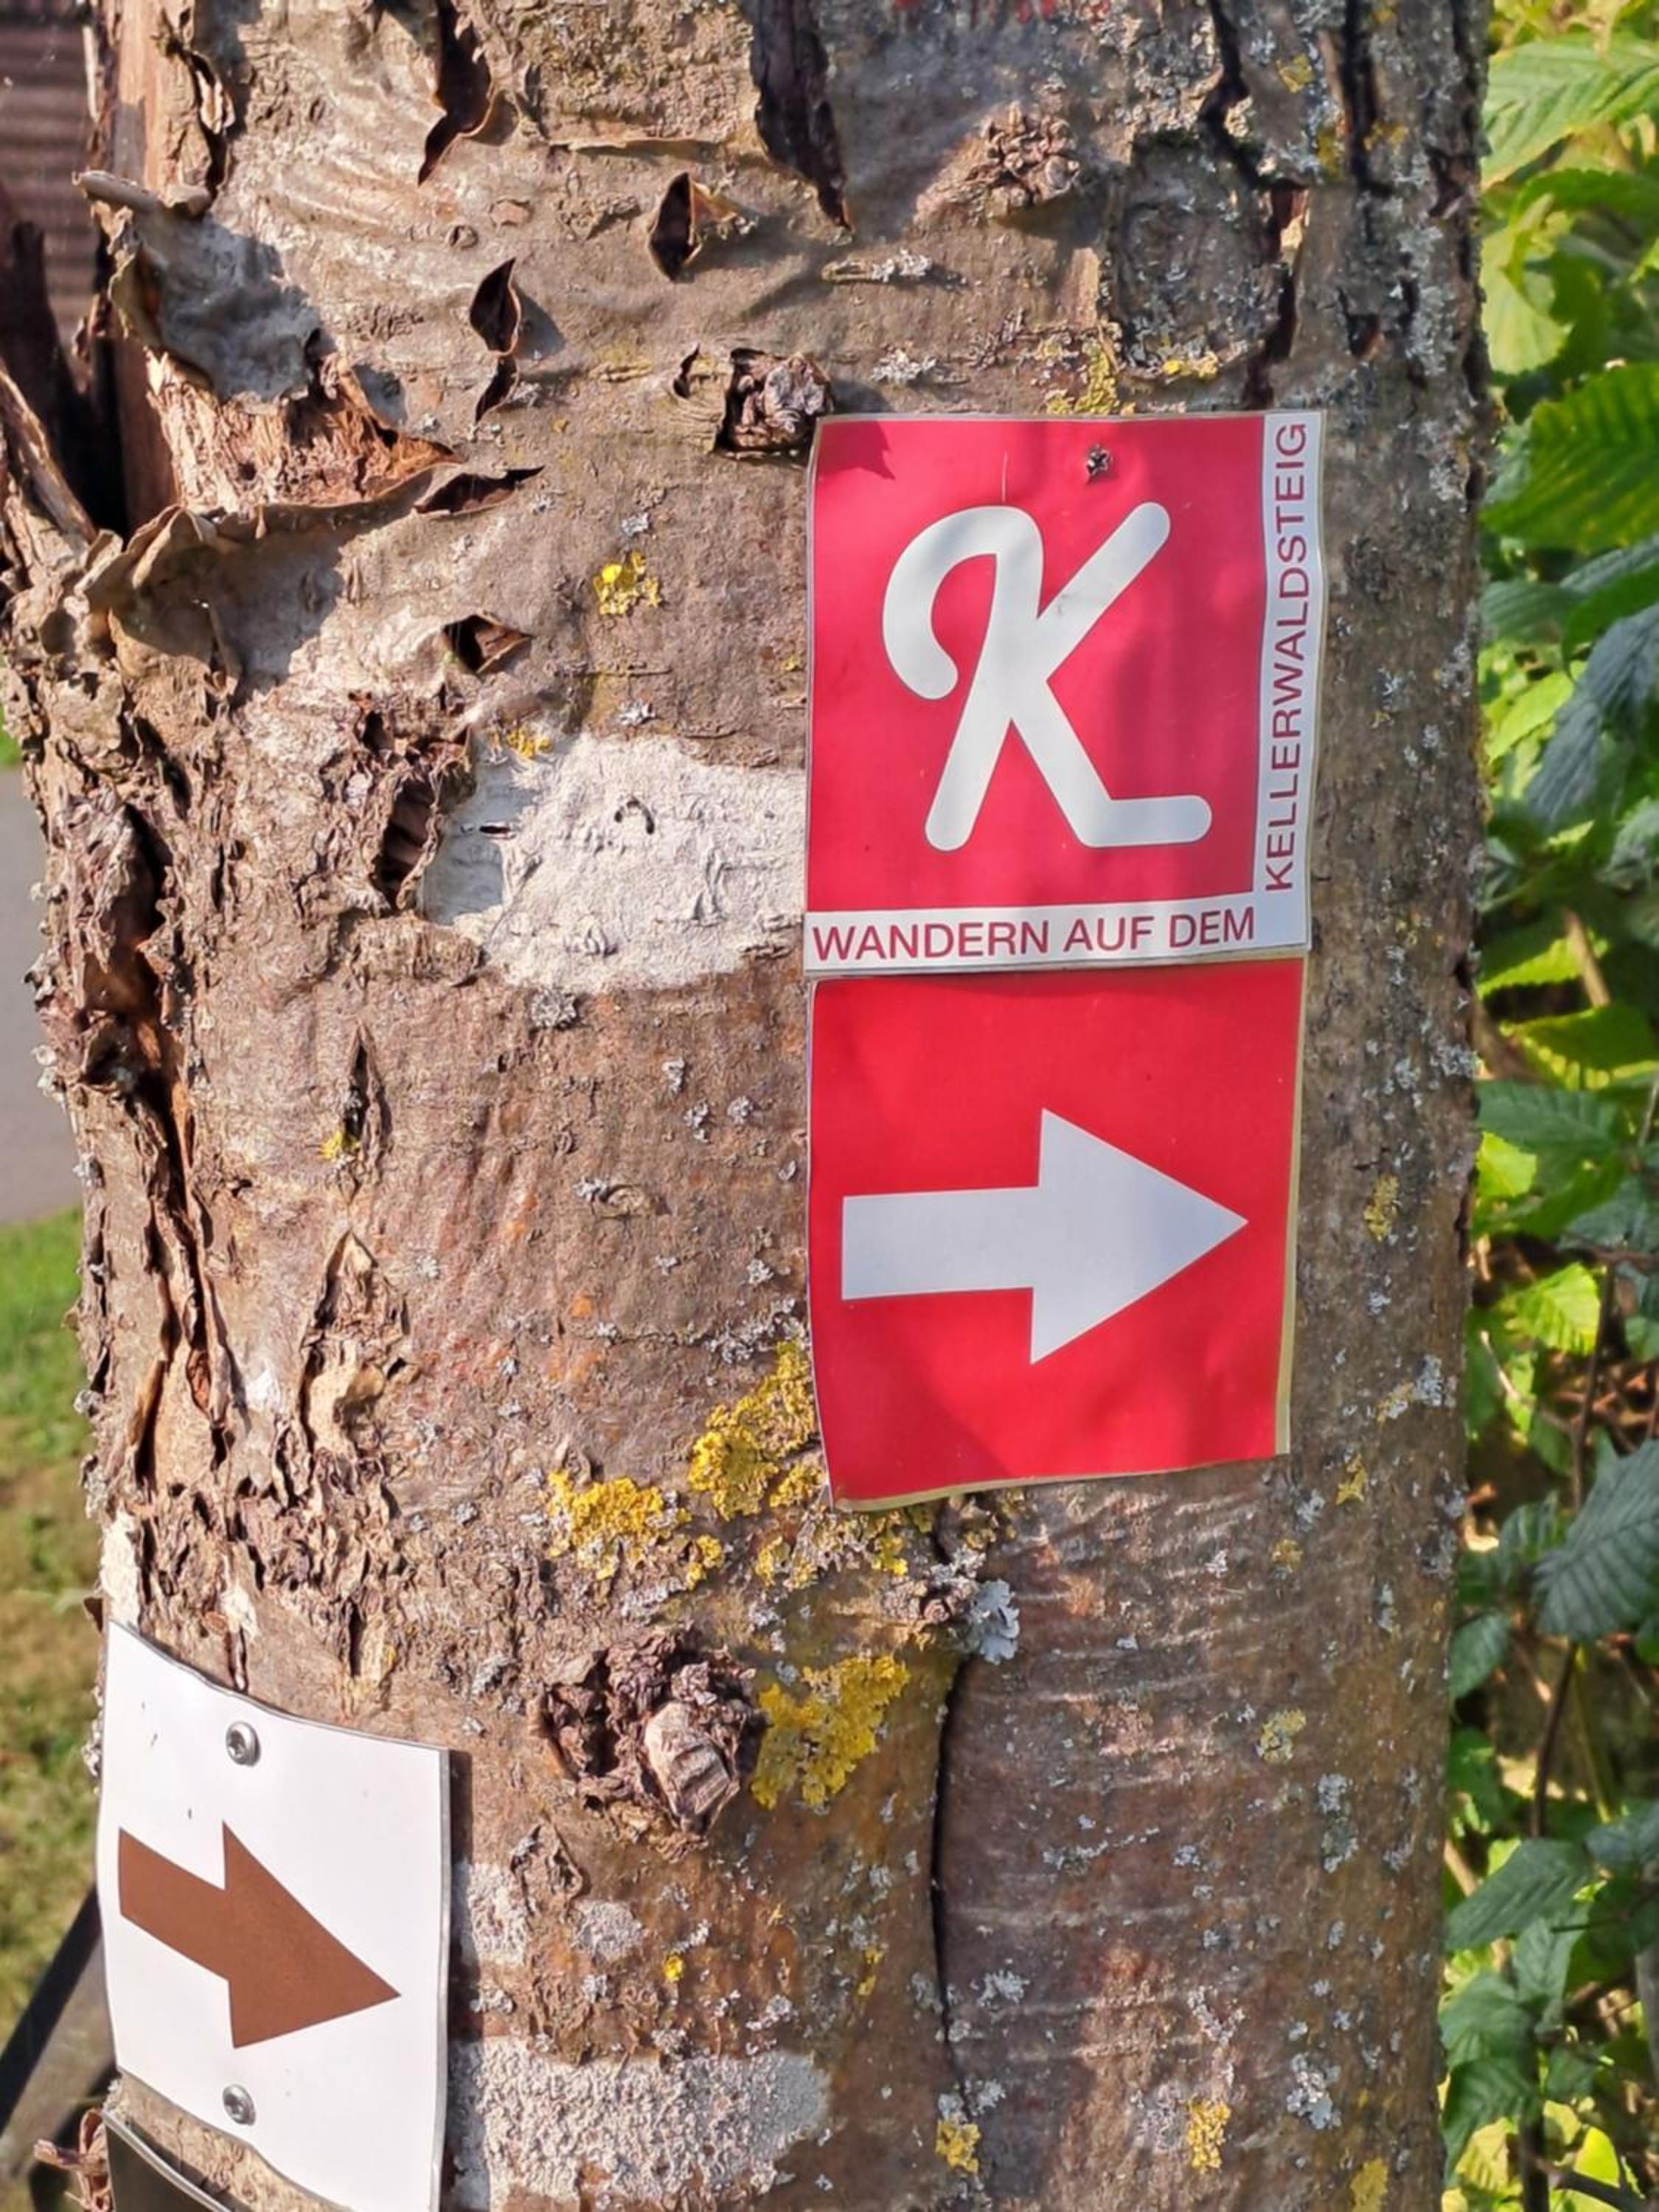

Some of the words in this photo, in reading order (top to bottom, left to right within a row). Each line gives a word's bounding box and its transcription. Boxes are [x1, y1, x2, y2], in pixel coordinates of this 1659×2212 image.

[883, 502, 1213, 852] K
[1265, 423, 1310, 891] KELLERWALDSTEIG
[813, 919, 1050, 961] WANDERN
[1063, 915, 1155, 953] AUF
[1168, 907, 1254, 948] DEM
